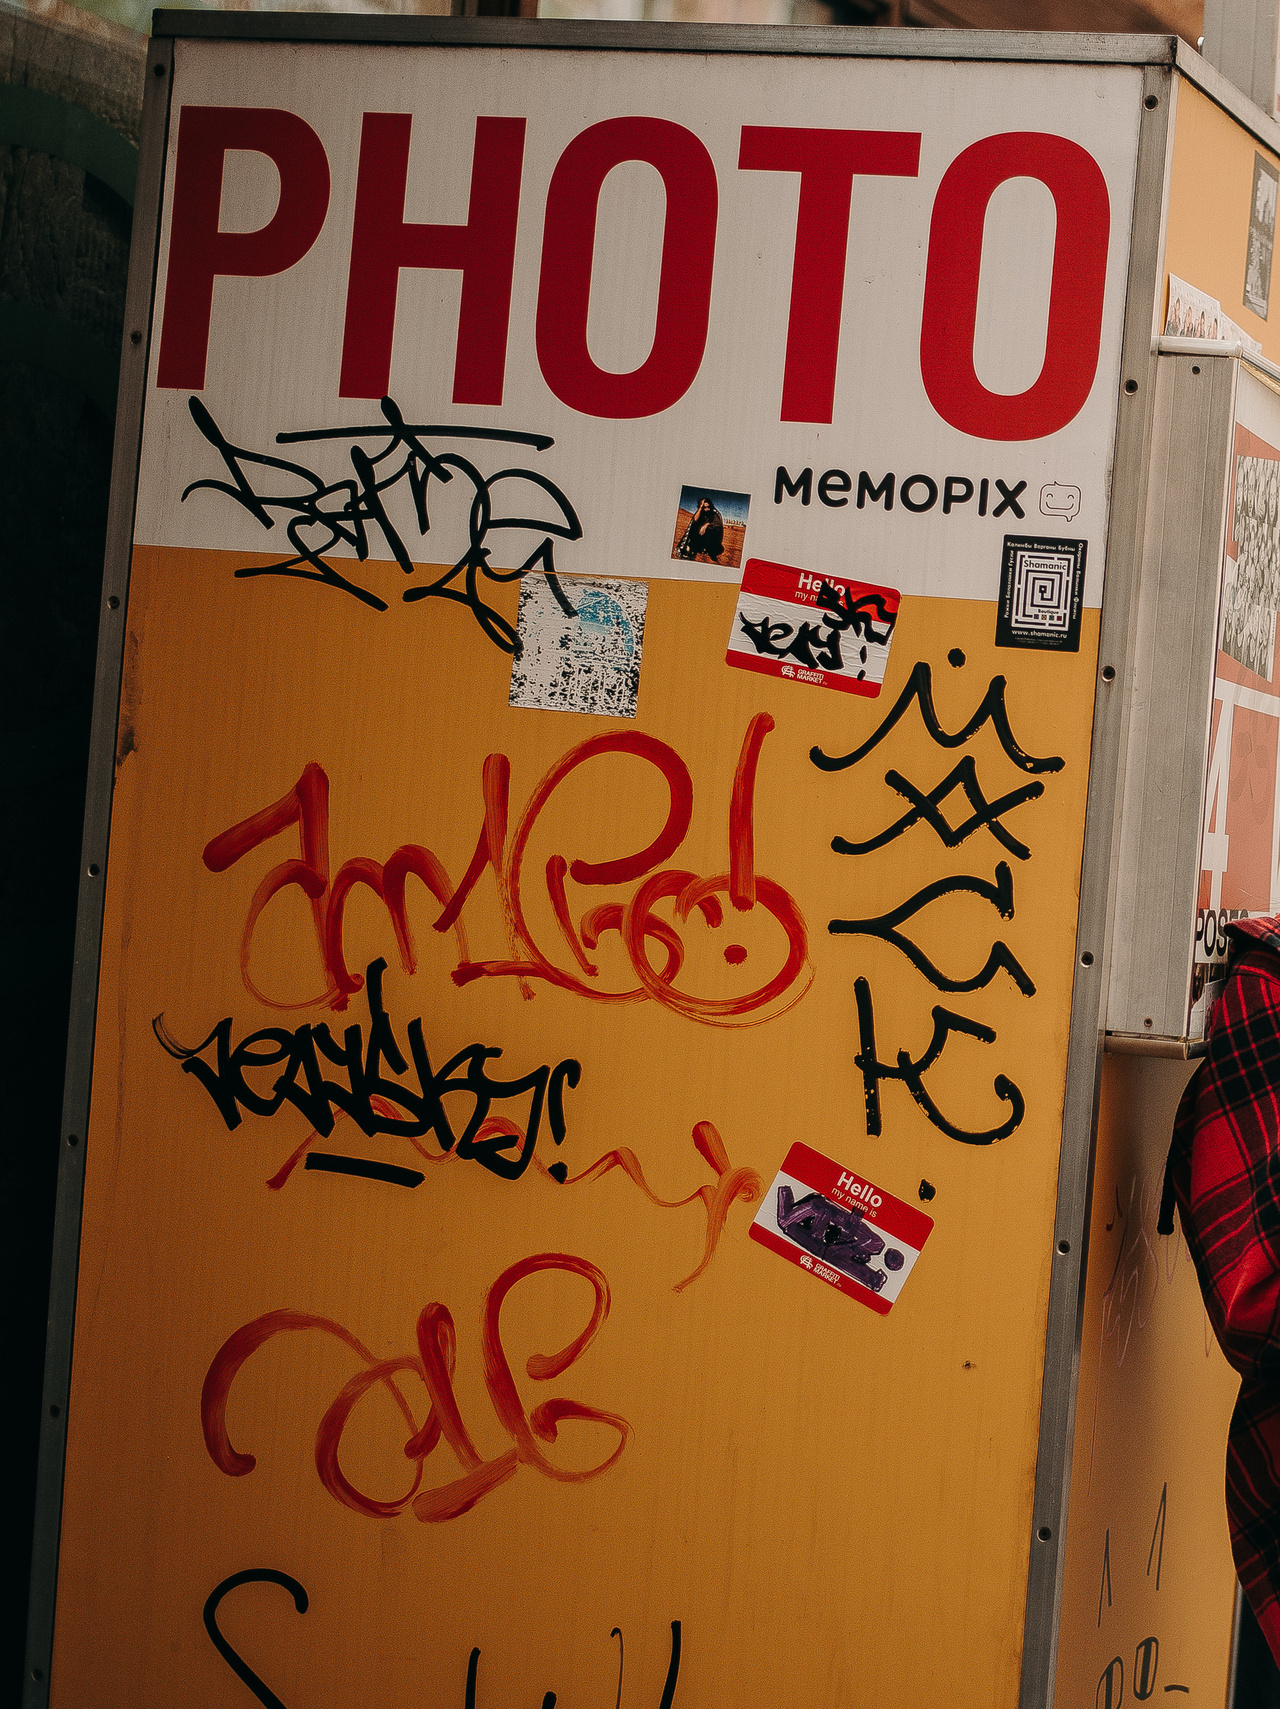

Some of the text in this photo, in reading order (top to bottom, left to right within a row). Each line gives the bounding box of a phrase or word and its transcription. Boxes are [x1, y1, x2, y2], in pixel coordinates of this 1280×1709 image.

[156, 104, 1111, 442] PHOTO
[1023, 560, 1067, 571] Shamanic
[794, 591, 809, 602] my
[1011, 629, 1068, 639] www.shamanic.ru
[1200, 698, 1230, 911] 4
[831, 1187, 878, 1218] my name is
[836, 1171, 883, 1208] Hello
